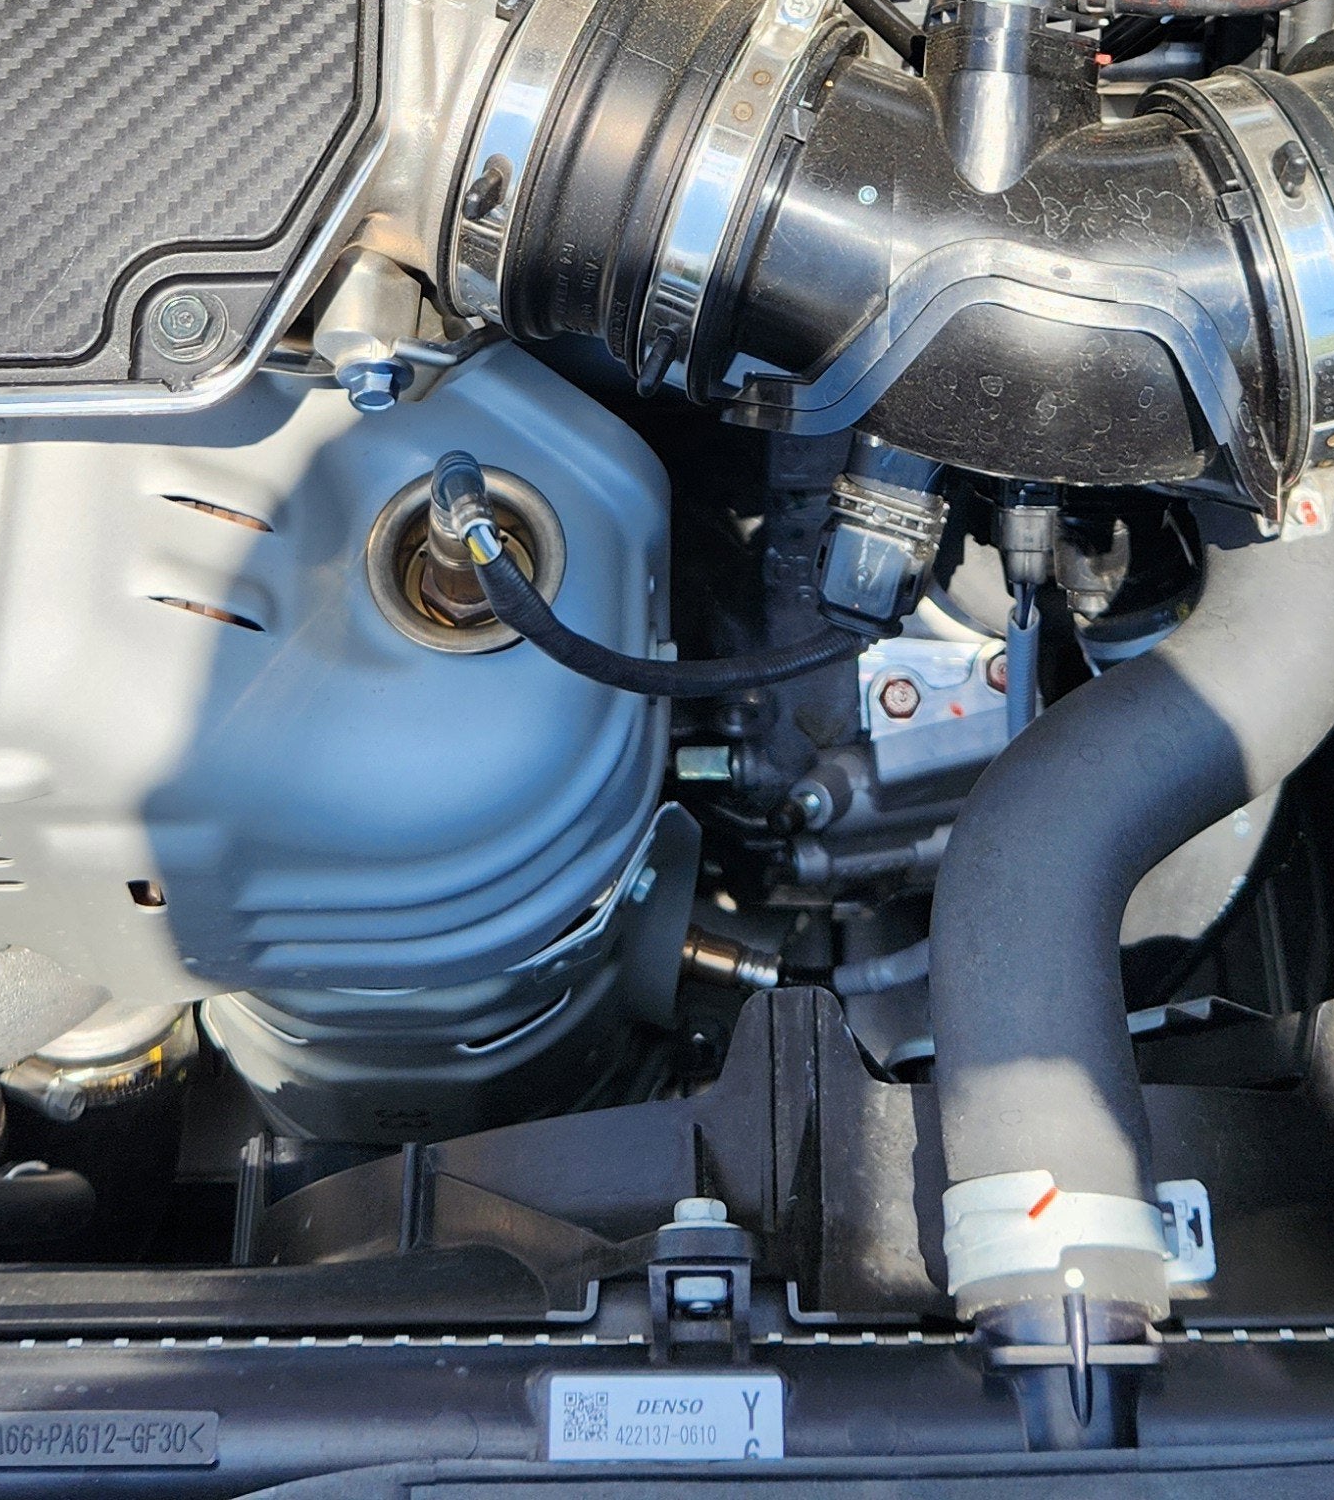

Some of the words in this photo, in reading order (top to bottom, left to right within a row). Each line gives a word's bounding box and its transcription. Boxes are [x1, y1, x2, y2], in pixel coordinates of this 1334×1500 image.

[635, 1398, 704, 1416] DENSO
[742, 1390, 761, 1431] Y
[614, 1424, 717, 1447] 422137-0610
